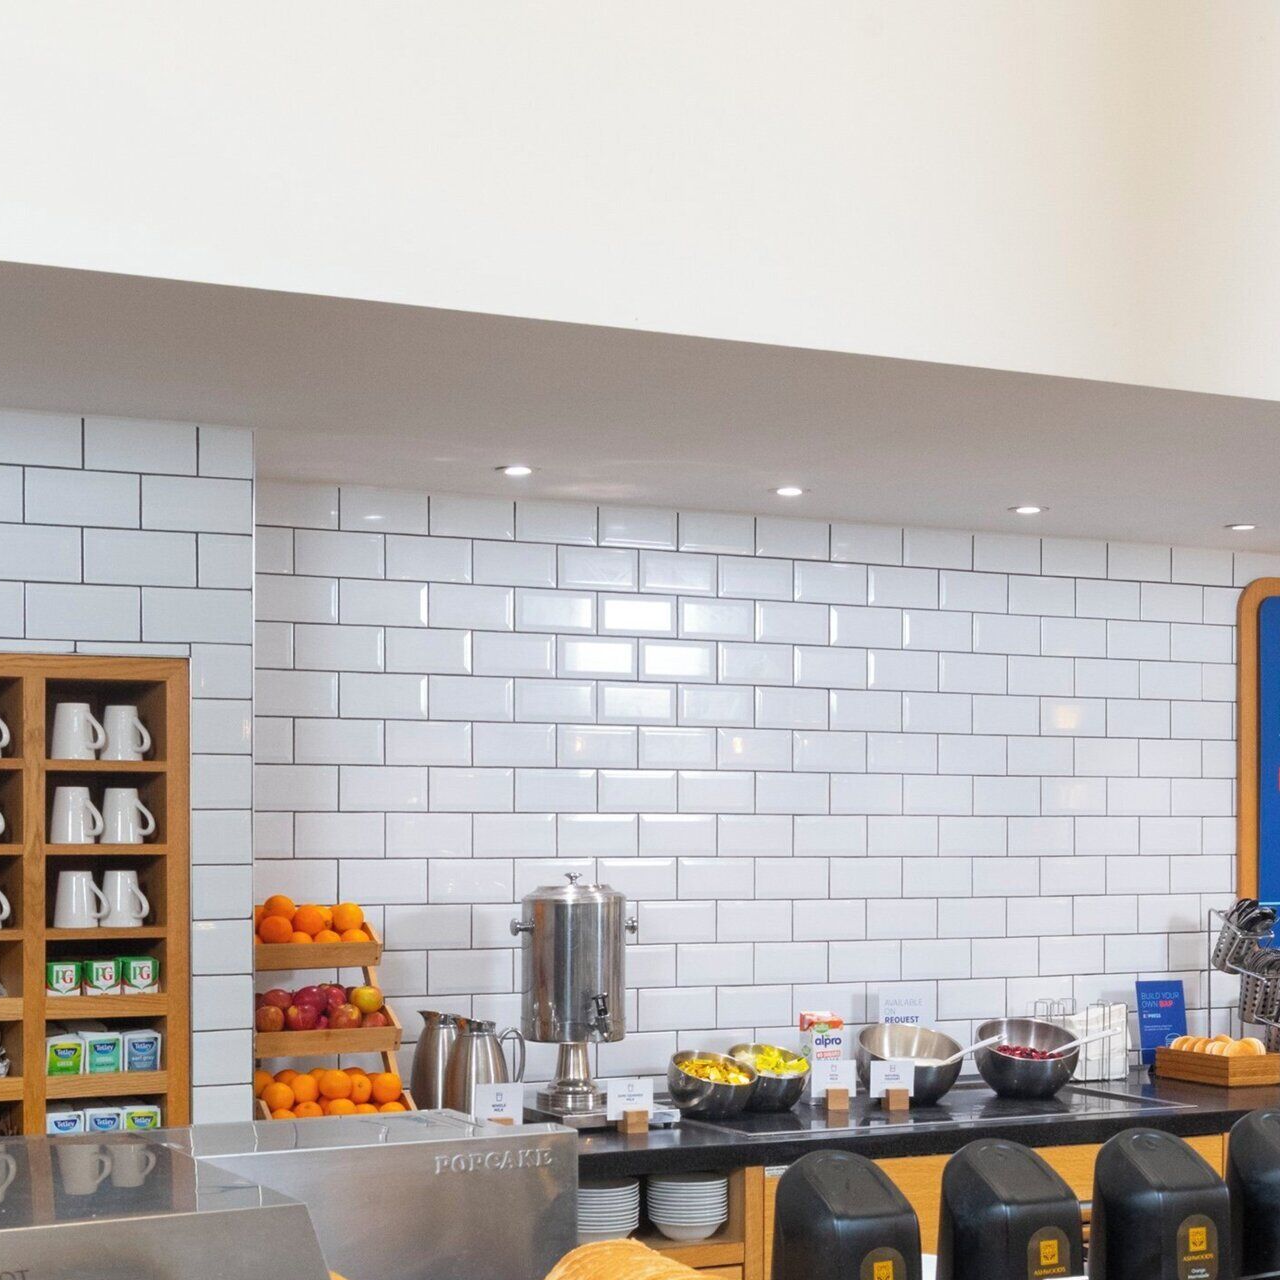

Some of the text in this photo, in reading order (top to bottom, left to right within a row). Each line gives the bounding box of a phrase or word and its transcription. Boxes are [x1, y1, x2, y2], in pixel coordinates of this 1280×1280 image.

[55, 969, 73, 984] PG
[95, 966, 113, 981] PG
[133, 965, 150, 980] PG
[1141, 992, 1160, 1000] BUILD
[884, 999, 923, 1007] AVAILABLE
[1141, 1000, 1158, 1008] OWN
[884, 1016, 919, 1024] REQUEST
[135, 1041, 152, 1050] Tetley
[815, 1034, 842, 1048] alpro
[95, 1043, 114, 1051] Tetley
[56, 1048, 76, 1057] Tetley
[57, 1119, 78, 1128] Tetley
[96, 1118, 114, 1126] Tetley
[133, 1116, 152, 1125] Tetley
[434, 1147, 553, 1175] POPCAKE
[1183, 1253, 1215, 1262] ASHWOODS
[1034, 1266, 1066, 1277] ASHWOODS
